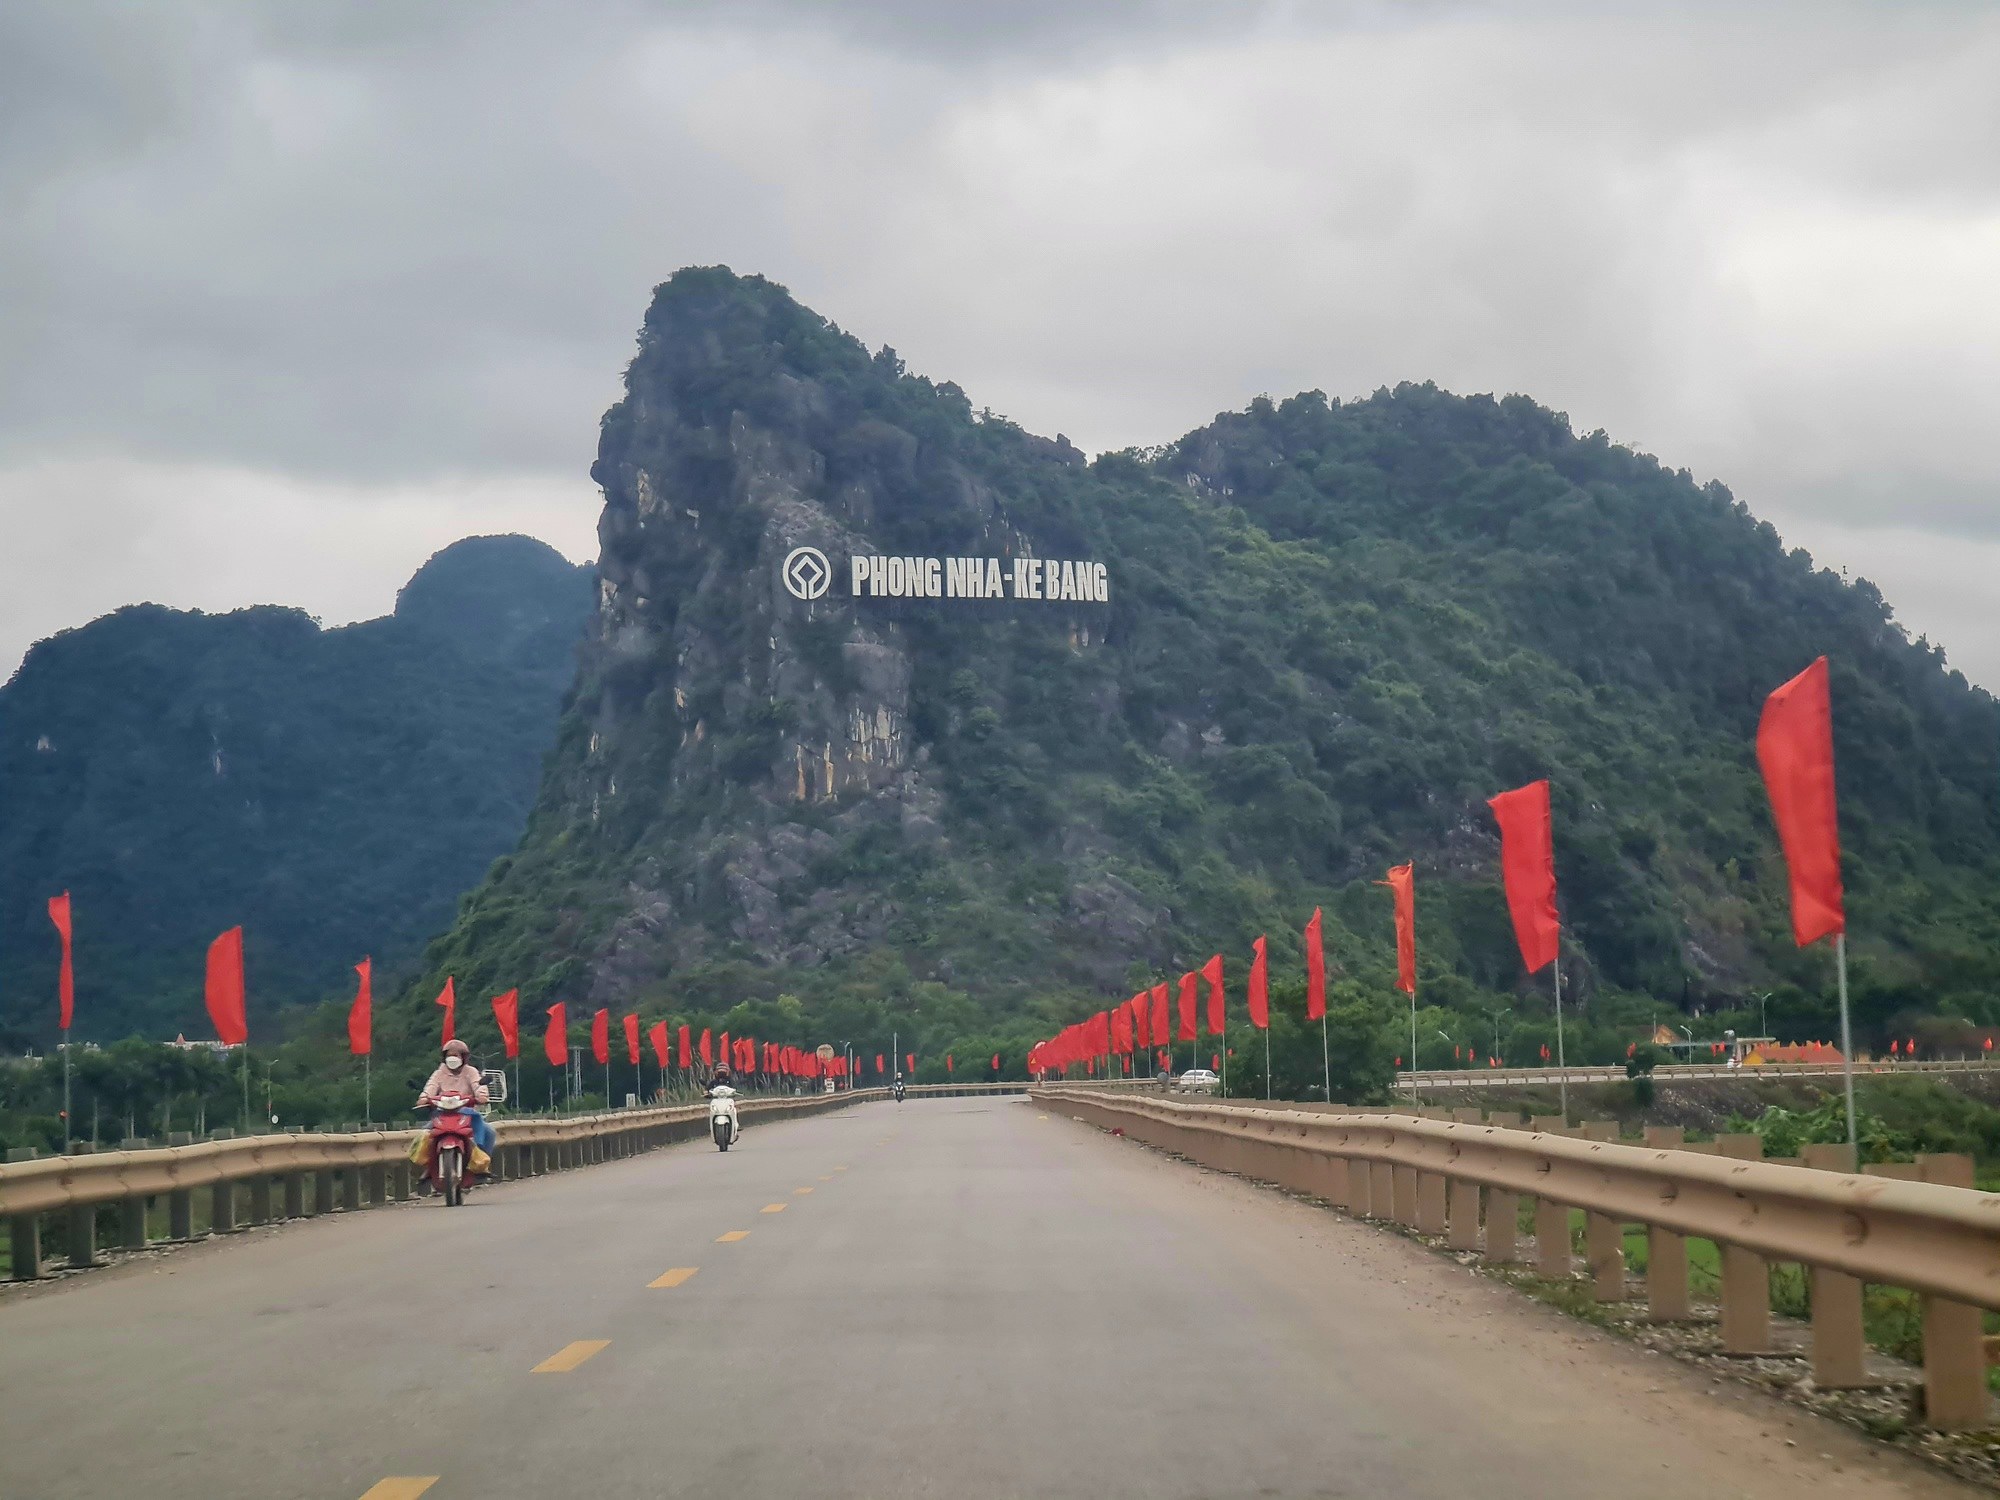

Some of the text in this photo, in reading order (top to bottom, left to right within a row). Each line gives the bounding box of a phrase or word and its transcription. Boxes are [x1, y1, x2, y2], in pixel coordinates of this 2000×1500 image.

[851, 555, 1109, 602] PHONG NHA-KE BANG
